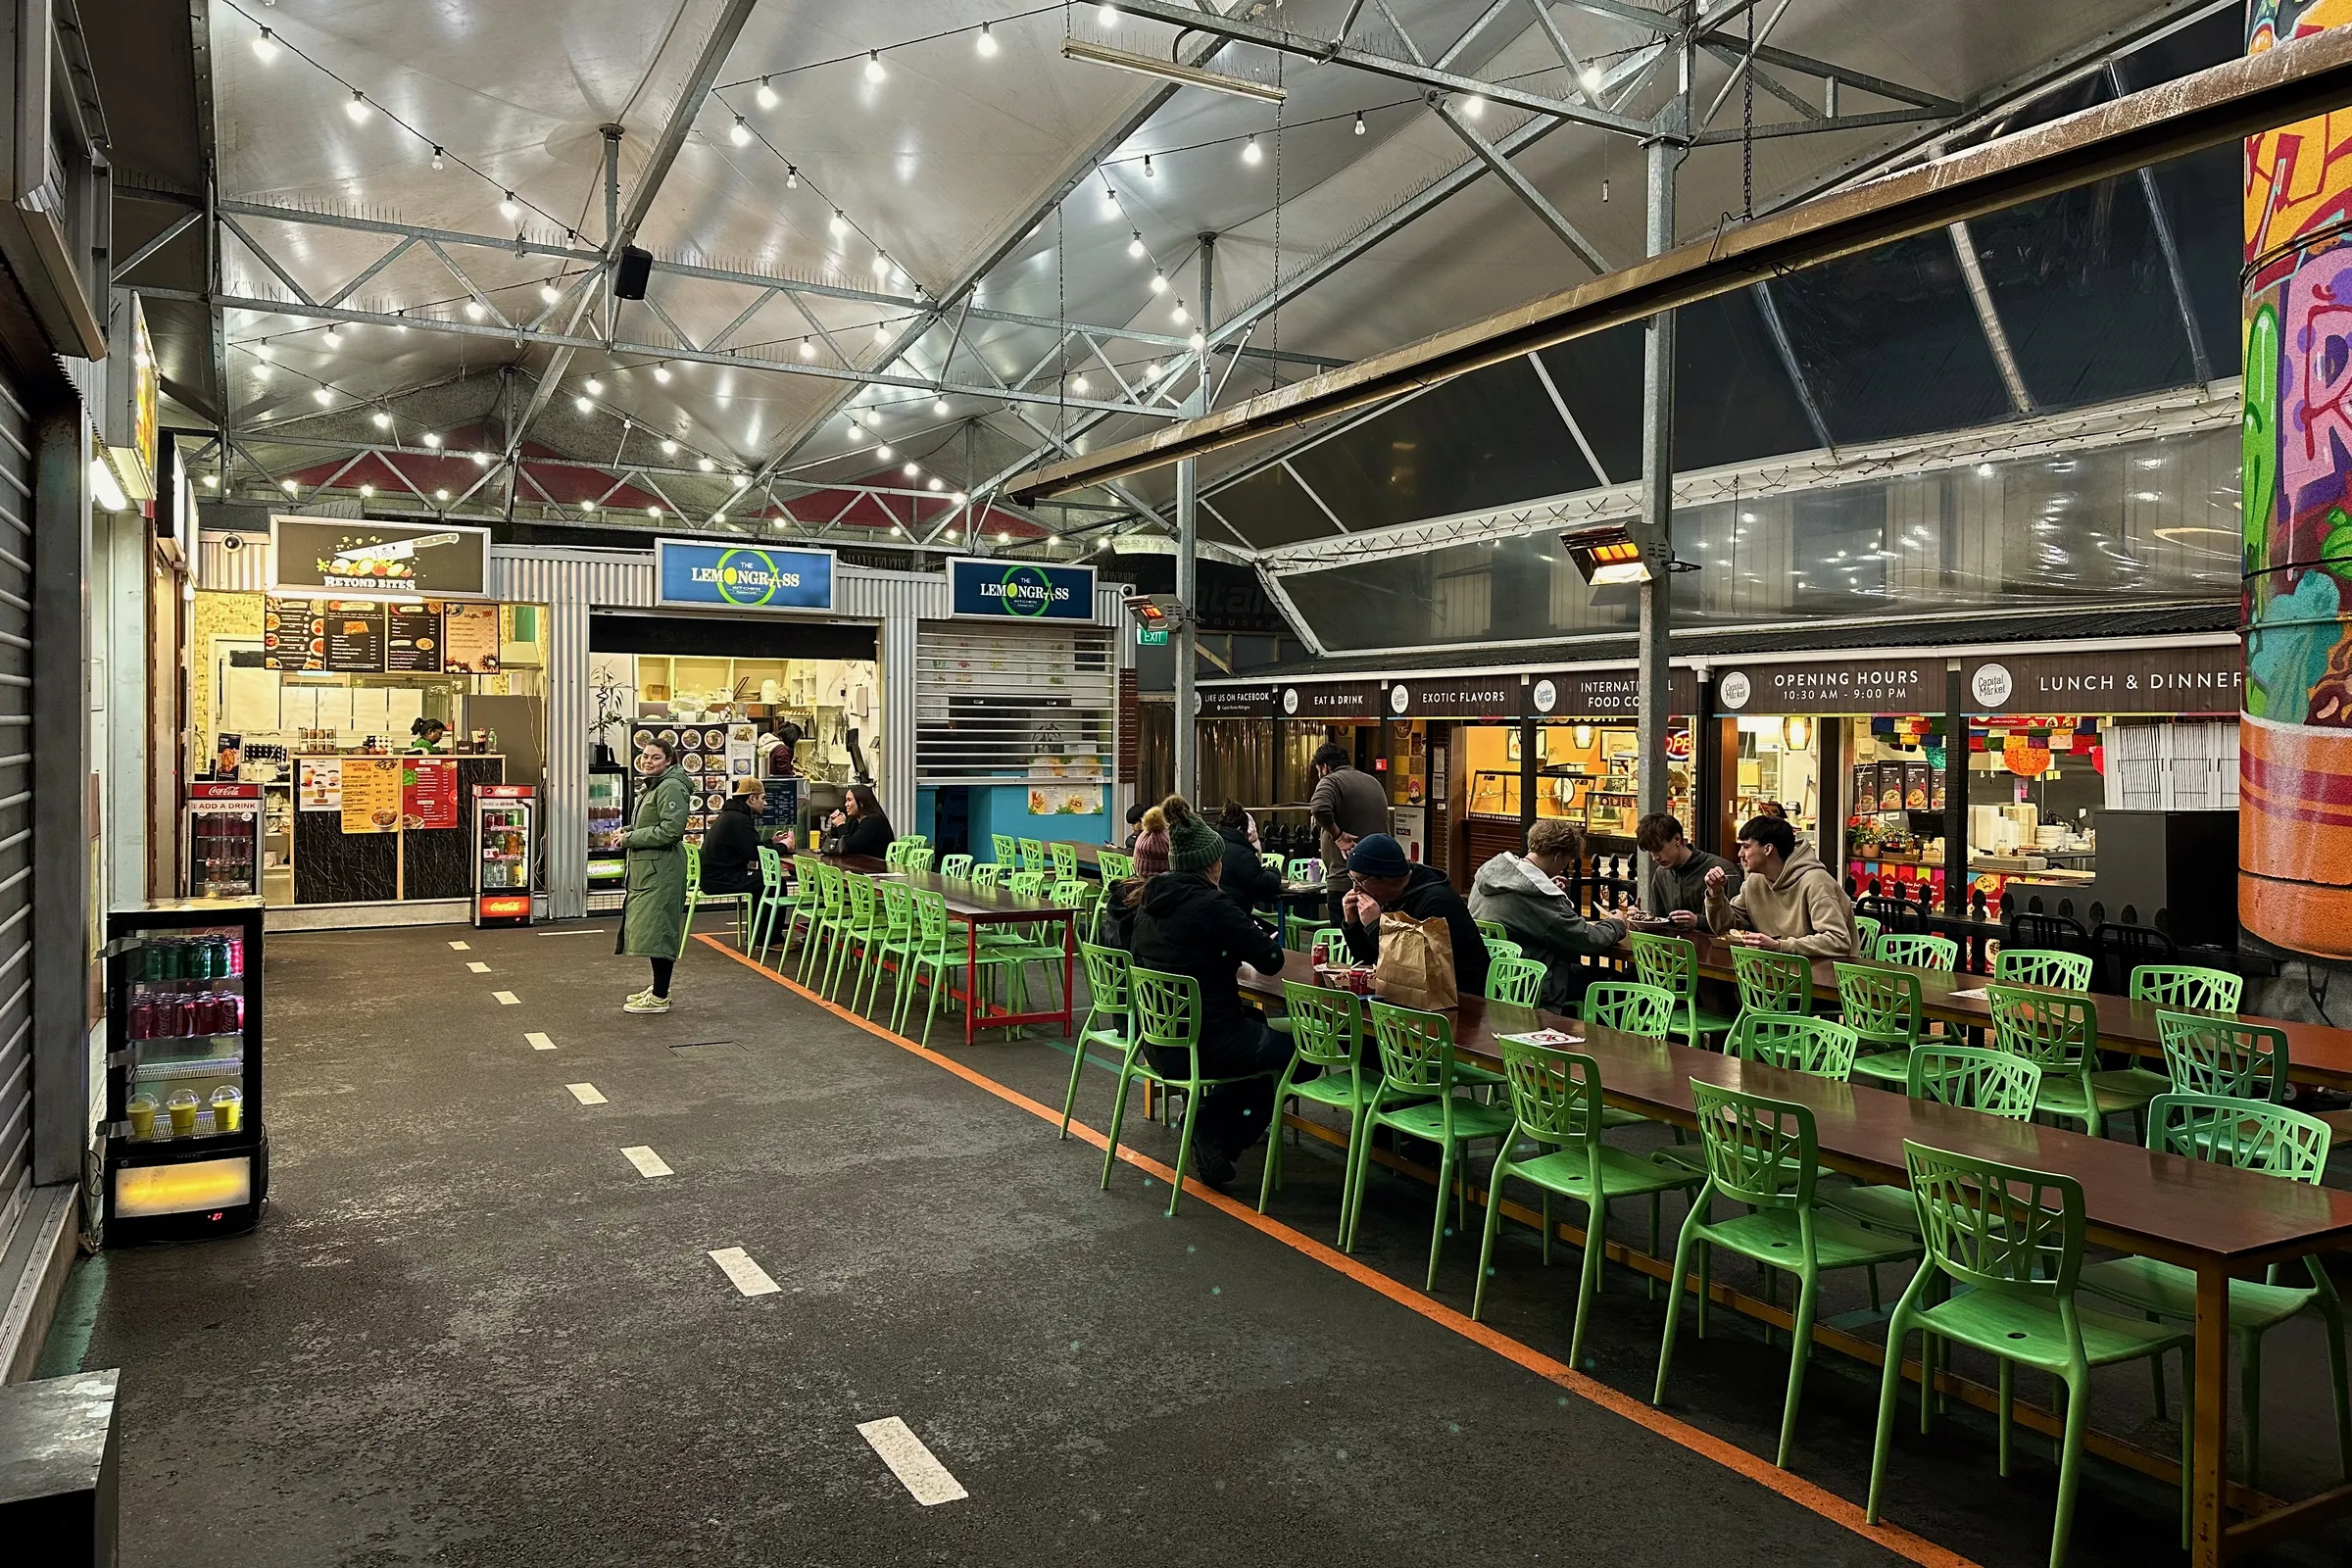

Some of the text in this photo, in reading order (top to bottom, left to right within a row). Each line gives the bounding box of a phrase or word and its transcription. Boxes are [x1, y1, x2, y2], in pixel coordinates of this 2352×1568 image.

[691, 566, 800, 588] LEMONGRASS
[980, 582, 1070, 601] LEMONGRASS
[1144, 631, 1162, 643] EXIT
[1774, 670, 1919, 687] OPENING HOURS
[1978, 673, 2004, 688] Capital
[2039, 674, 2114, 691] LUNCH
[2126, 674, 2139, 690] &
[1580, 679, 1674, 693] INTERNATIL
[1979, 684, 2006, 697] Market
[1204, 693, 1217, 702] LIKE
[1217, 693, 1226, 702] US
[1226, 692, 1236, 702] ON
[1237, 692, 1270, 702] FACEBOOK
[1313, 695, 1363, 706] EAT & DRINK
[1422, 691, 1505, 704] EXOTIC FLAVORS
[1783, 690, 1816, 700] 10:30
[1820, 689, 1838, 700] AM
[1853, 688, 1883, 699] 9:00
[1887, 688, 1907, 699] PM
[1588, 697, 1621, 709] FOOD
[1666, 737, 1690, 754] OPE
